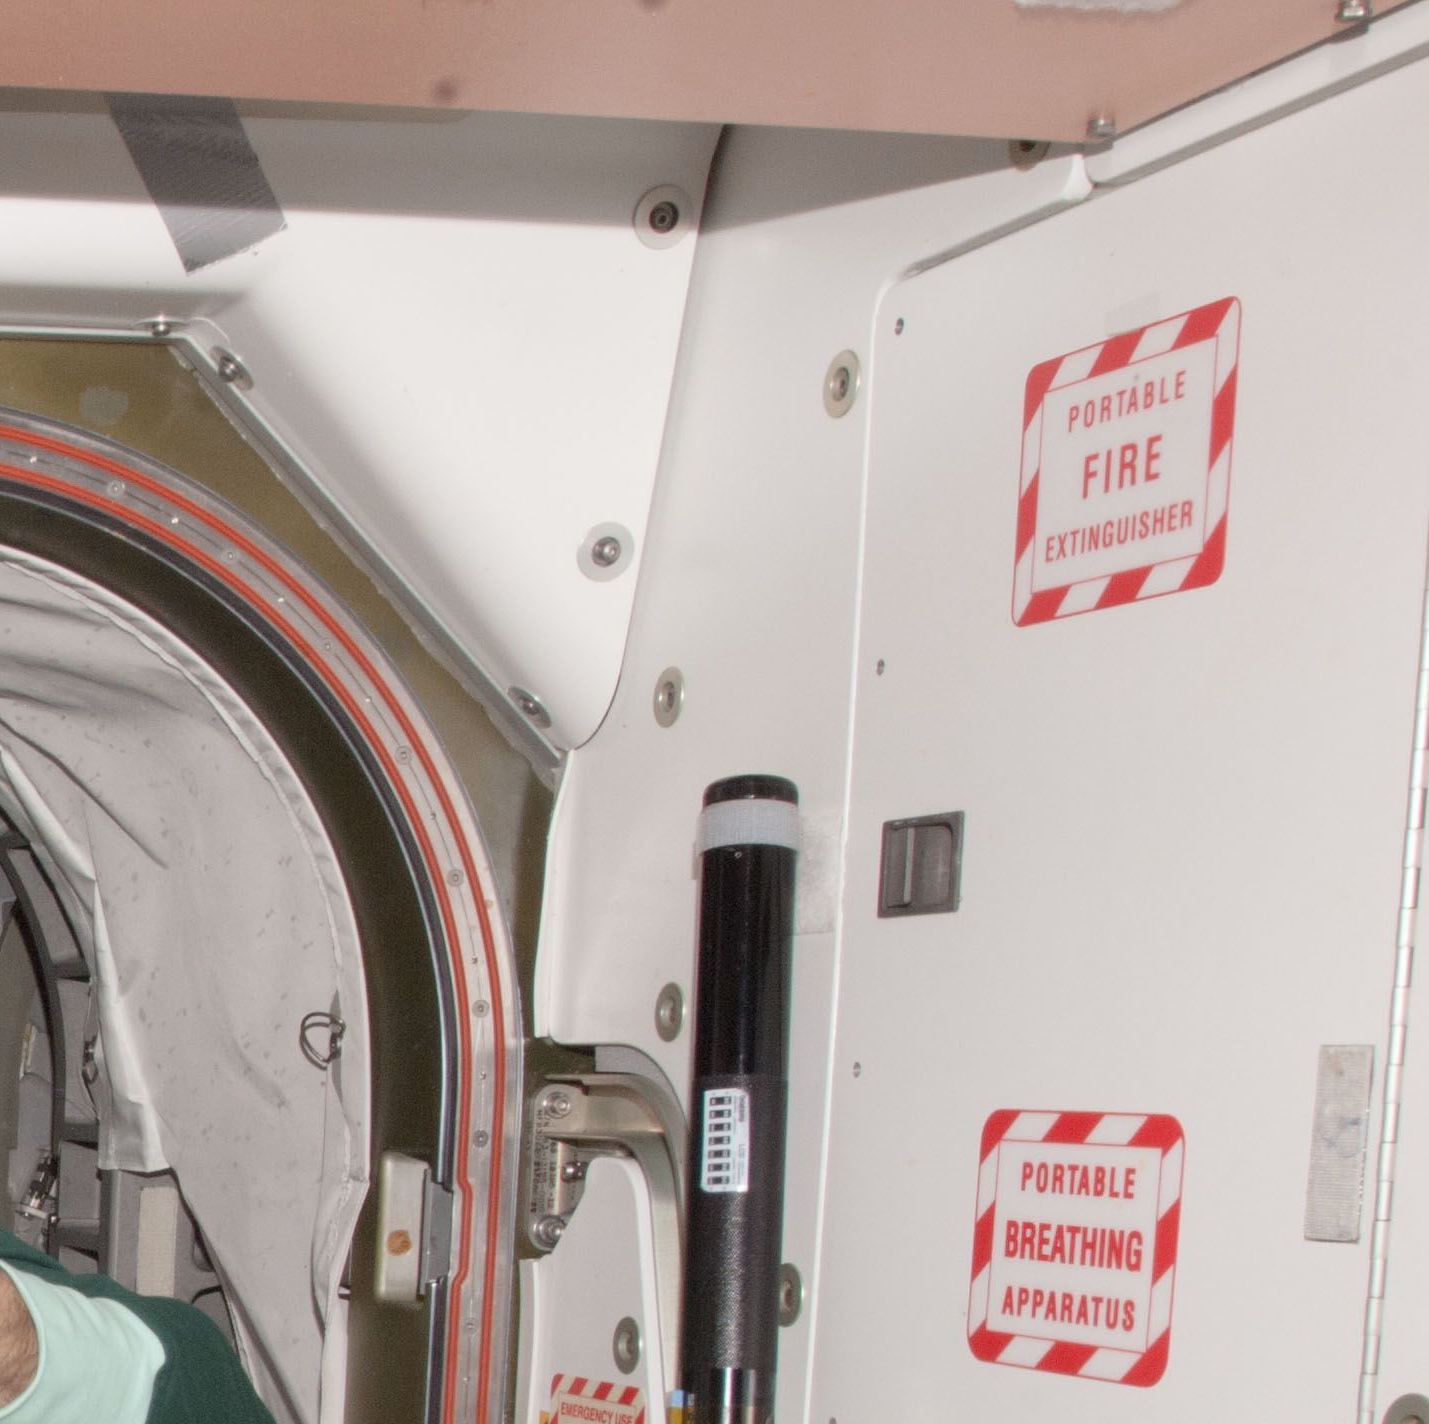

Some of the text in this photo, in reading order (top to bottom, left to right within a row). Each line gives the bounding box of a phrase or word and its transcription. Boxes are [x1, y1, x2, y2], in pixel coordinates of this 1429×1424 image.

[1067, 369, 1187, 433] PORTABLE
[1082, 434, 1163, 500] FIRE
[1044, 500, 1193, 563] EXTINGUISHER
[1021, 1161, 1136, 1199] PORTABLE
[1004, 1219, 1143, 1272] BREATHING
[1001, 1285, 1135, 1332] APPARATUS
[560, 1402, 614, 1424] EMERGENCY
